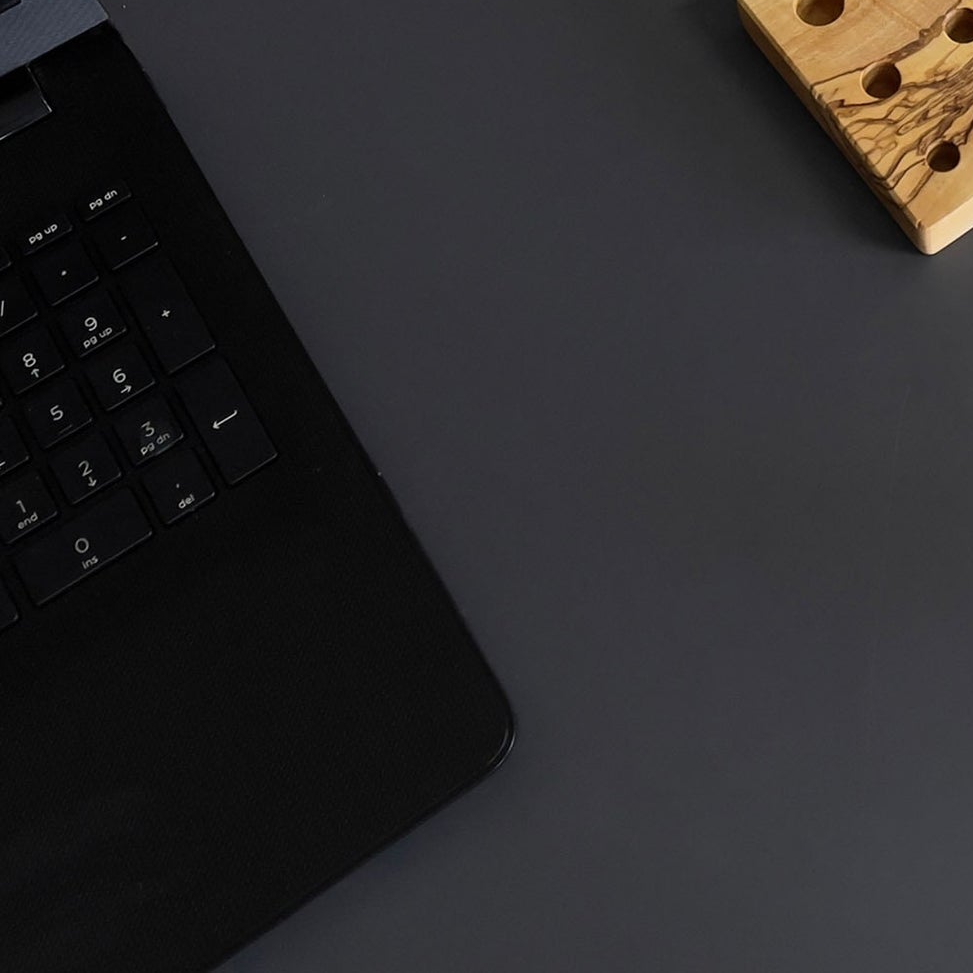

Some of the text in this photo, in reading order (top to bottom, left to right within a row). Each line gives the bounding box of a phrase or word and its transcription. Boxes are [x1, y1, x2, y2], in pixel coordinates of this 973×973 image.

[89, 189, 118, 210] pg dn
[28, 223, 58, 245] pg up
[84, 316, 98, 332] 9
[83, 327, 113, 349] pg up
[22, 352, 37, 368] 8
[112, 368, 127, 384] 6
[50, 404, 64, 421] 5
[140, 421, 155, 437] 3
[140, 432, 171, 456] pg dn
[78, 460, 93, 477] 2
[16, 499, 26, 513] 1
[178, 494, 196, 510] del
[17, 512, 39, 530] end
[82, 555, 99, 570] ins
